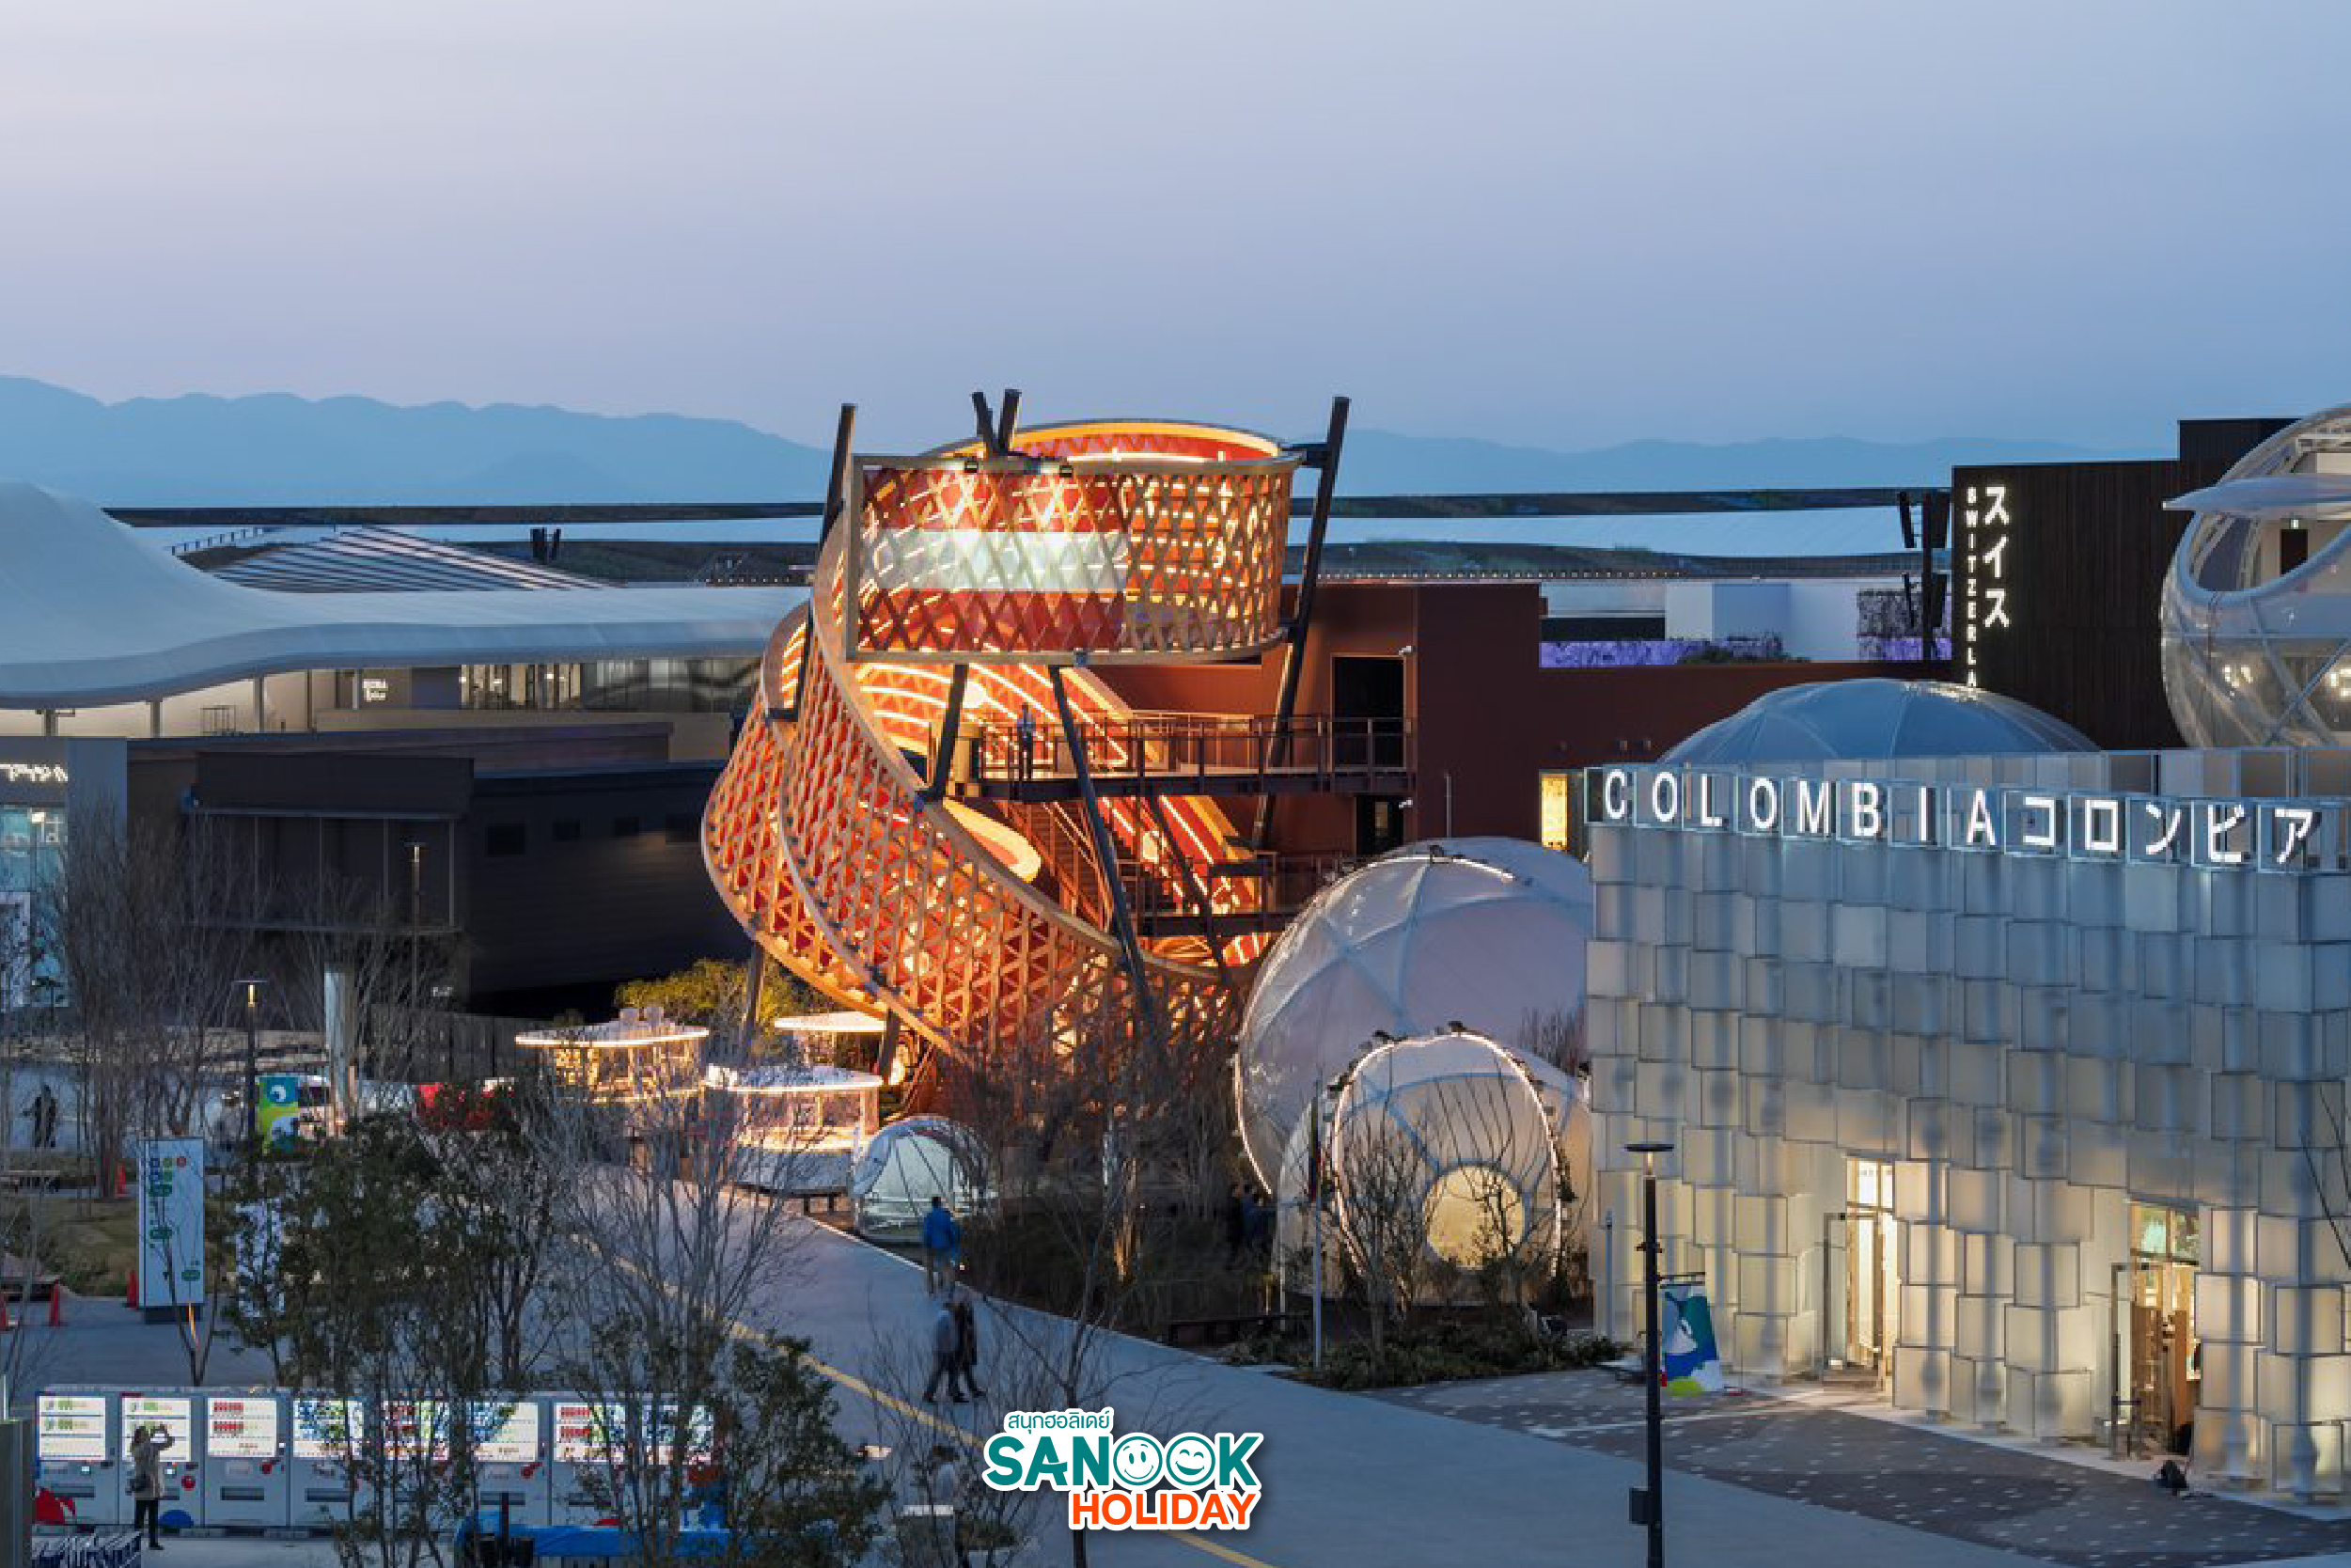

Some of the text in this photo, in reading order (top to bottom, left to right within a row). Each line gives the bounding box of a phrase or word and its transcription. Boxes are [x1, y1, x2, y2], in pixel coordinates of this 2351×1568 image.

[1983, 485, 2010, 628] スイス
[1603, 769, 1997, 846] COLOMBIA
[2023, 795, 2314, 864] コロンビア
